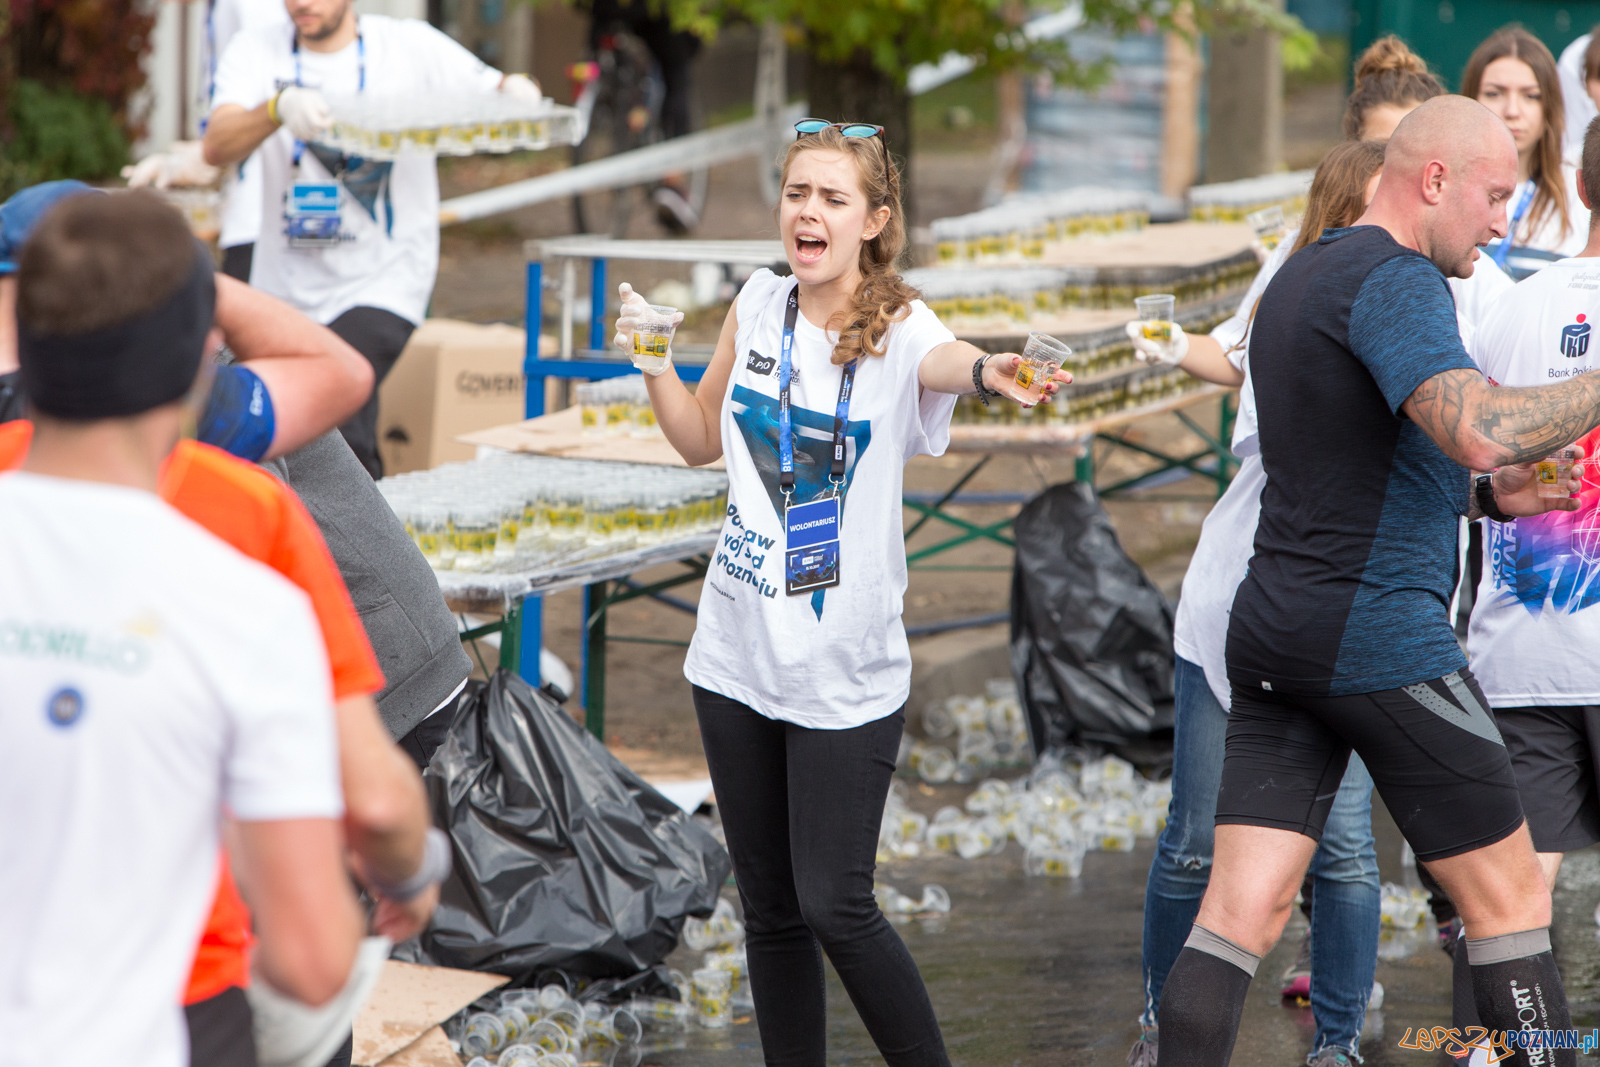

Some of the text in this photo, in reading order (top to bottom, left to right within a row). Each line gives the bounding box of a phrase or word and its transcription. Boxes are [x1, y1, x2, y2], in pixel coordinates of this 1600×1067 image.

[1548, 368, 1570, 378] Bank
[782, 460, 791, 472] 18
[789, 516, 836, 533] WOLONTARIUSZ
